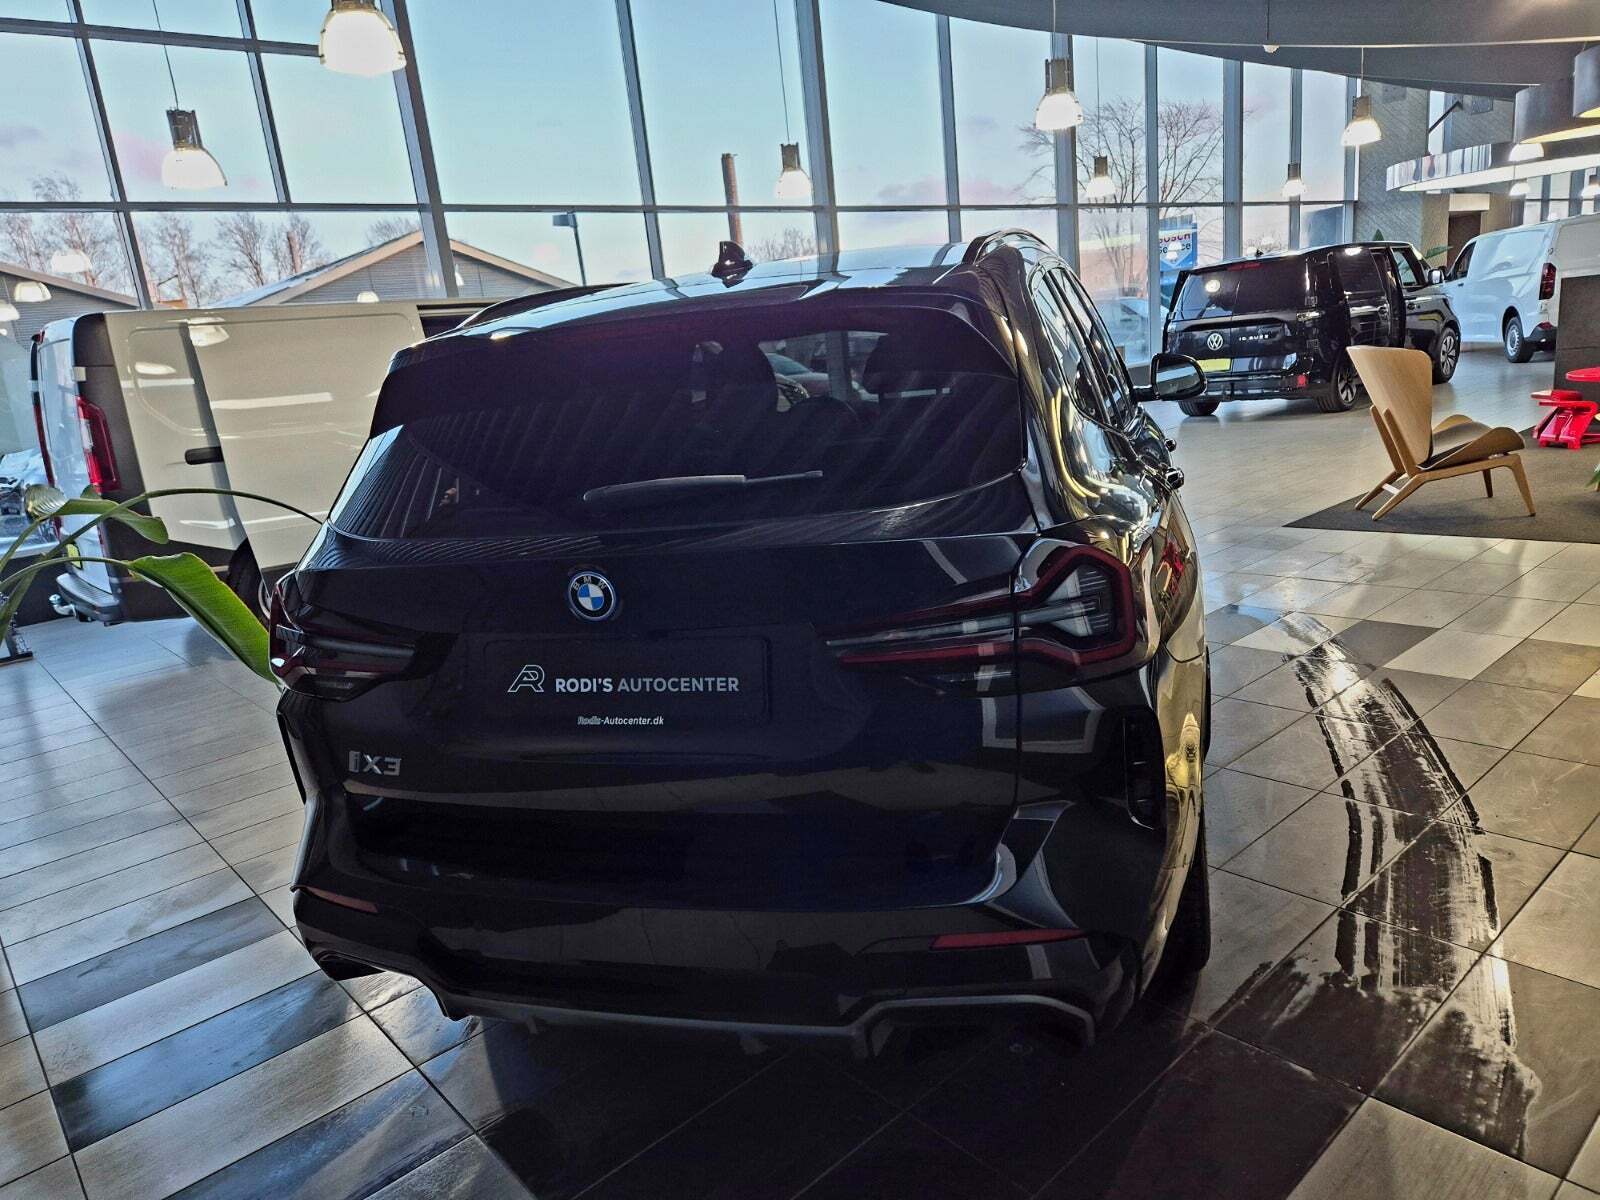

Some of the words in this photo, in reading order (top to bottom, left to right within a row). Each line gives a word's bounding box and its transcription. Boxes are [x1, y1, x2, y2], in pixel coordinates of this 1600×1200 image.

[1207, 333, 1223, 351] VW
[572, 575, 607, 590] BMW
[555, 678, 613, 693] RODI'S
[617, 677, 740, 692] AUTOCENTER
